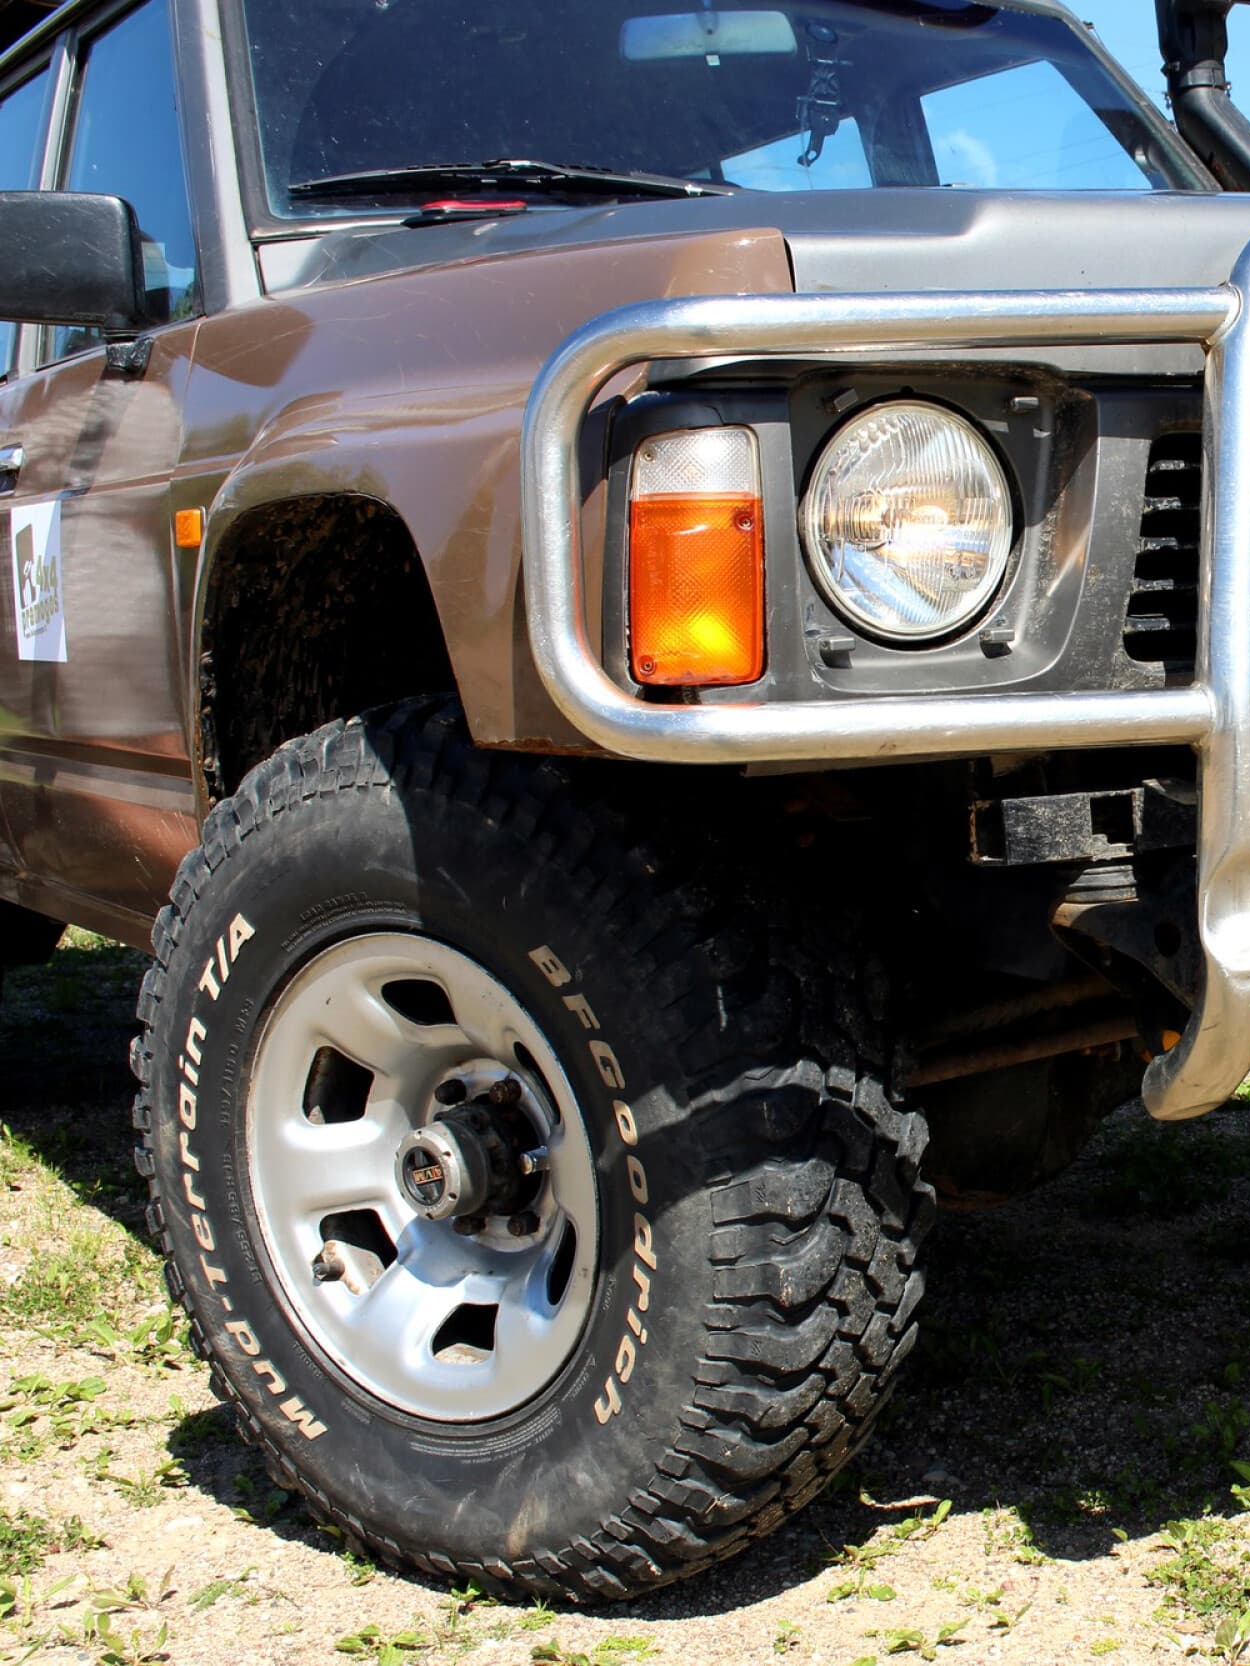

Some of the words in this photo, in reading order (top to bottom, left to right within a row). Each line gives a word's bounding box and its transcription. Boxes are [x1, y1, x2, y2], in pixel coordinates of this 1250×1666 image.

[198, 912, 256, 1001] T/A
[178, 1017, 329, 1441] Mud-Terrain
[528, 944, 656, 1426] BFGoodrich
